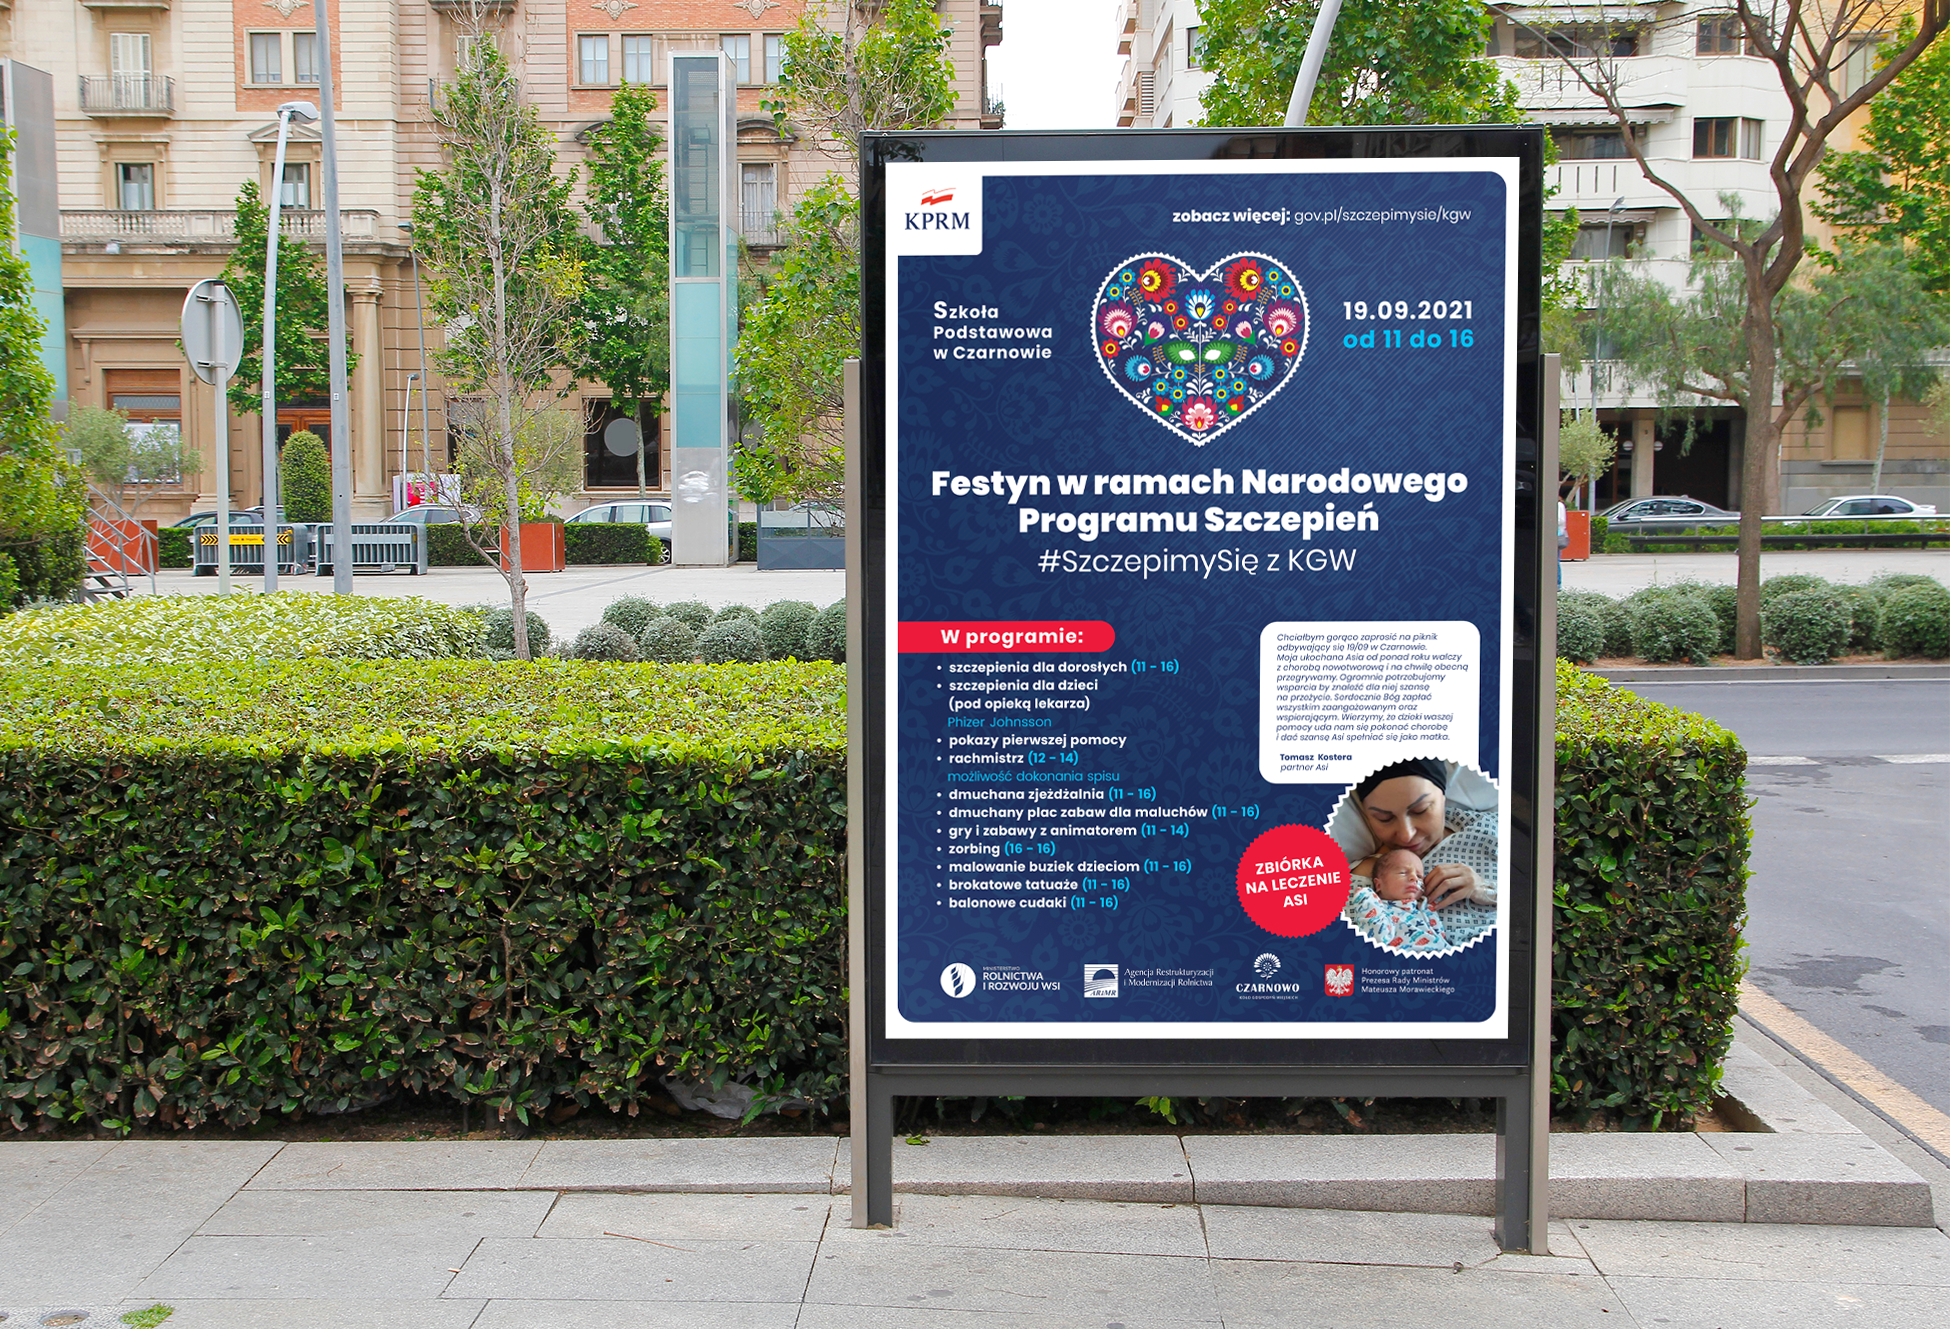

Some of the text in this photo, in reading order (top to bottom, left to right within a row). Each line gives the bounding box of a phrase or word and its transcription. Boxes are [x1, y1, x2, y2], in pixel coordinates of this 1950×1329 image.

[906, 213, 969, 229] KPRM
[1172, 205, 1471, 225] zobacz więcej: gov.pl/szczepimysie/kgw
[934, 301, 998, 319] Szkoła
[1343, 300, 1472, 320] 19.09.2021
[934, 325, 1052, 339] Podstawowa
[1343, 329, 1474, 348] od 11 do 16
[933, 344, 1052, 359] w Czarnowie
[932, 467, 1468, 505] Festyn w ramach Narodowego
[1019, 501, 1379, 541] Programu Szczepień
[1038, 548, 1357, 579] #SzczepimySię z KGW
[941, 627, 1083, 648] W programie:
[949, 659, 1179, 676] szczepienia dla dorosłych (11 16)
[949, 679, 1098, 694] szczepienia dla dzieci
[949, 695, 1090, 712] (pod opieką lekarza)
[948, 717, 1051, 727] Phizer Johnsson
[949, 734, 1127, 749] pokazy pierwszej pomocy
[949, 750, 1078, 766] rachmistrz (12 14)
[948, 770, 1120, 784] możliwość dokonania spisu
[948, 789, 1025, 799] dmuchana
[1109, 786, 1123, 802] (11
[1138, 786, 1156, 801] 16)
[949, 804, 1259, 821] dmuchany plac zabaw dla maluchów (11 16)
[948, 823, 1189, 839] gry i zabawy z animatorem (11 14)
[949, 841, 1056, 857] zorbing (16 16)
[949, 859, 1192, 874] malowanie buziek dzieciom (11 16)
[1255, 856, 1324, 875] ZBIÓRKA
[949, 877, 1130, 892] brokatowe tatuaże (11 16)
[1245, 871, 1341, 894] NA LECZENIE
[949, 895, 1118, 910] balonowe cudaki (11 16)
[1283, 893, 1308, 908] ASI
[983, 972, 1043, 980] ROLNICTWA
[1125, 969, 1213, 978] Agencja Restrukturyzacji
[1362, 968, 1400, 976] Honorowy
[988, 982, 1039, 990] ROZWOJU
[1041, 982, 1060, 990] WSI
[1129, 978, 1175, 988] Modernizacji
[1236, 984, 1300, 992] CZARNOWO
[1392, 977, 1410, 985] Rady
[1399, 986, 1454, 994] Morawieckiego
